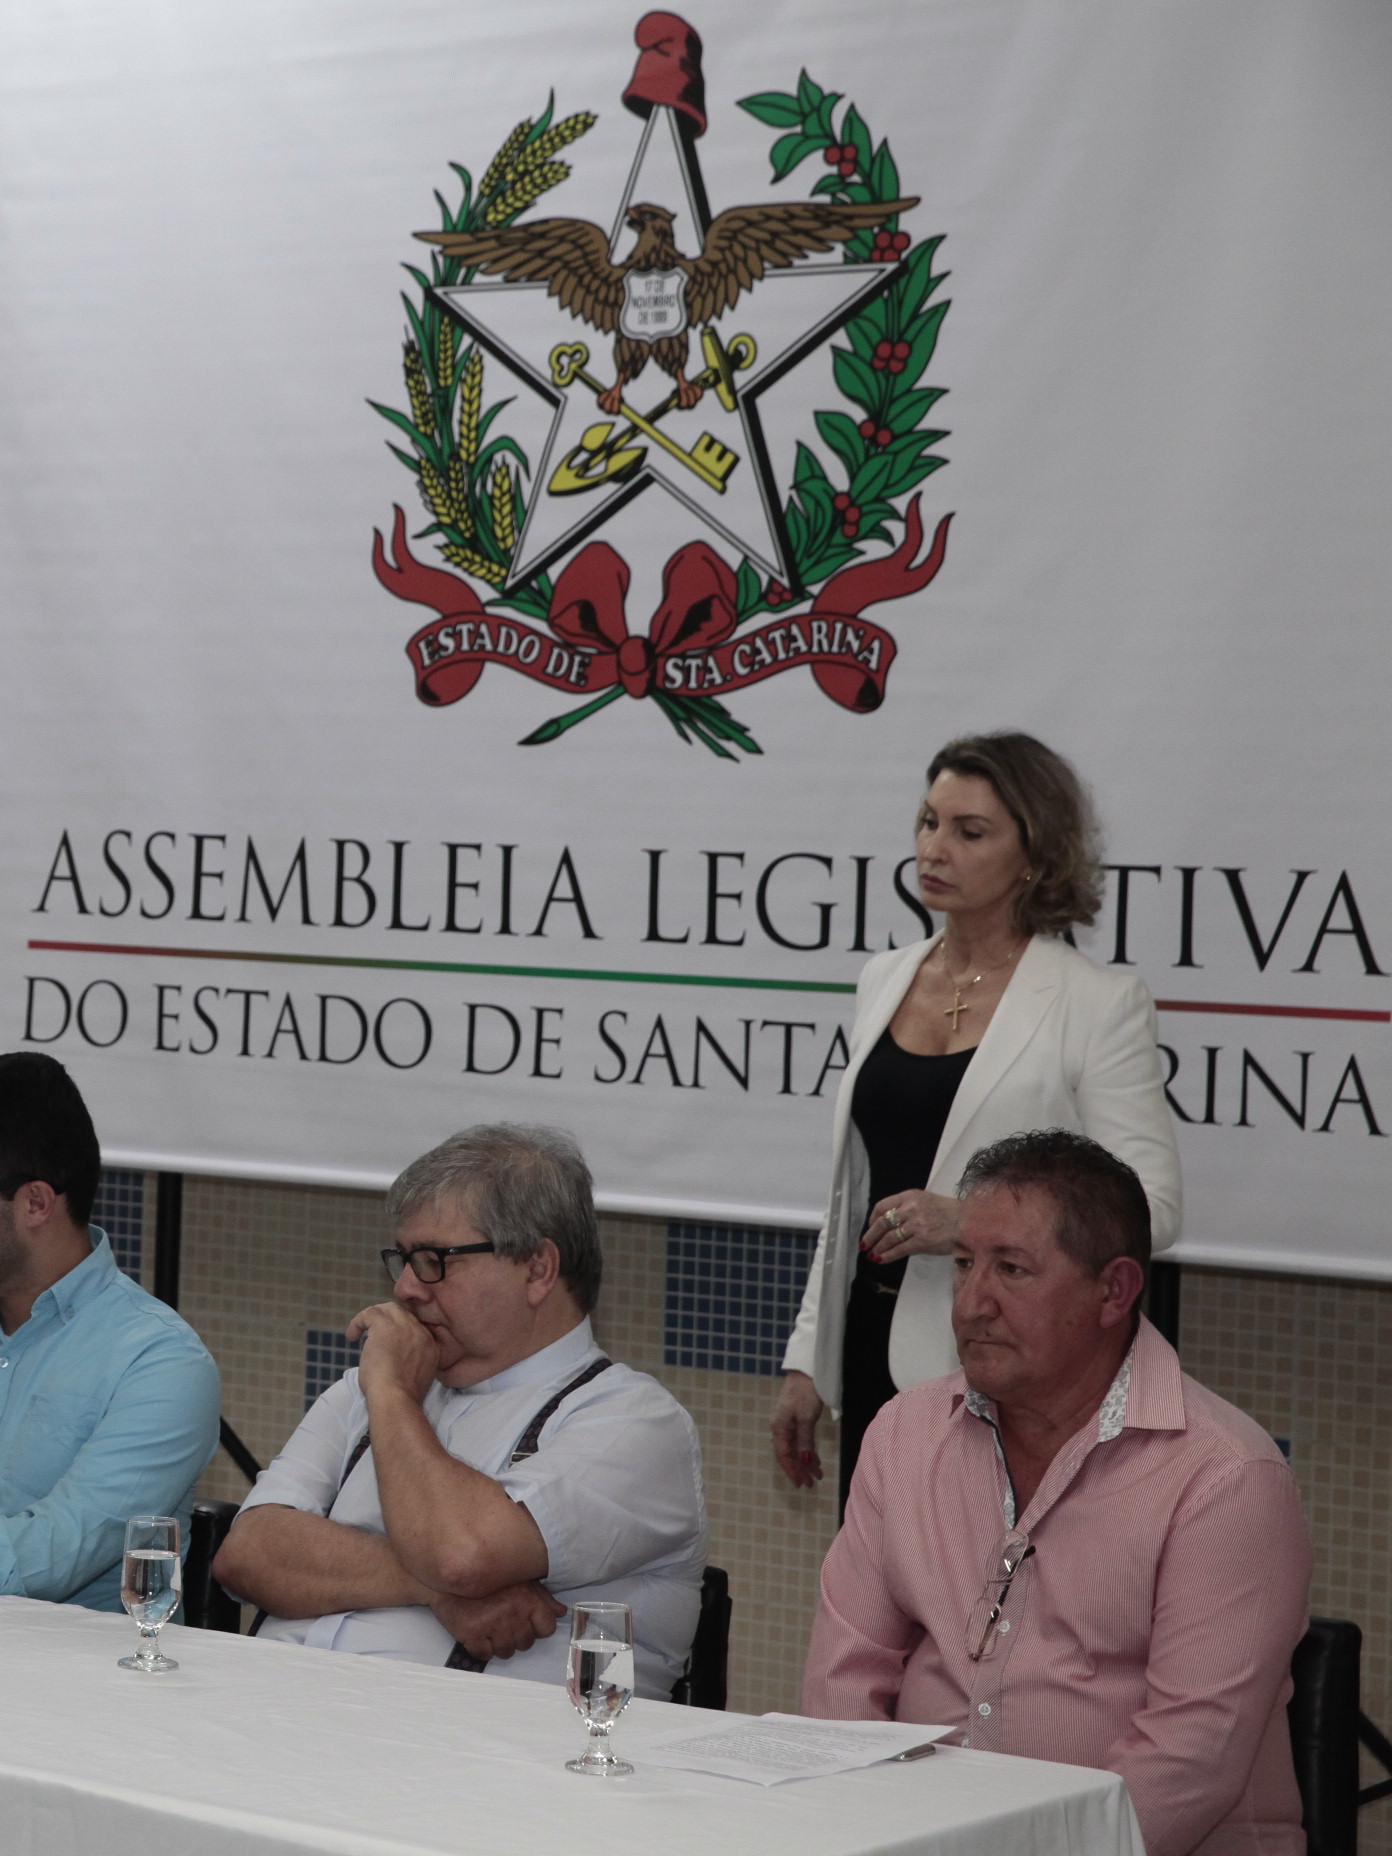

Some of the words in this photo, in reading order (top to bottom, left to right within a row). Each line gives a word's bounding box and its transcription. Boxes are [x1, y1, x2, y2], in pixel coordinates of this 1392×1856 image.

[418, 622, 541, 668] ESTADO
[546, 646, 591, 687] DE
[664, 655, 732, 690] STA.
[733, 619, 881, 676] CATARINA
[32, 828, 603, 940] ASSEMBLEIA
[641, 847, 1391, 976] LEGISTIVA
[24, 977, 128, 1047] DO
[153, 983, 433, 1070] ESTADO
[463, 1003, 565, 1079] DE
